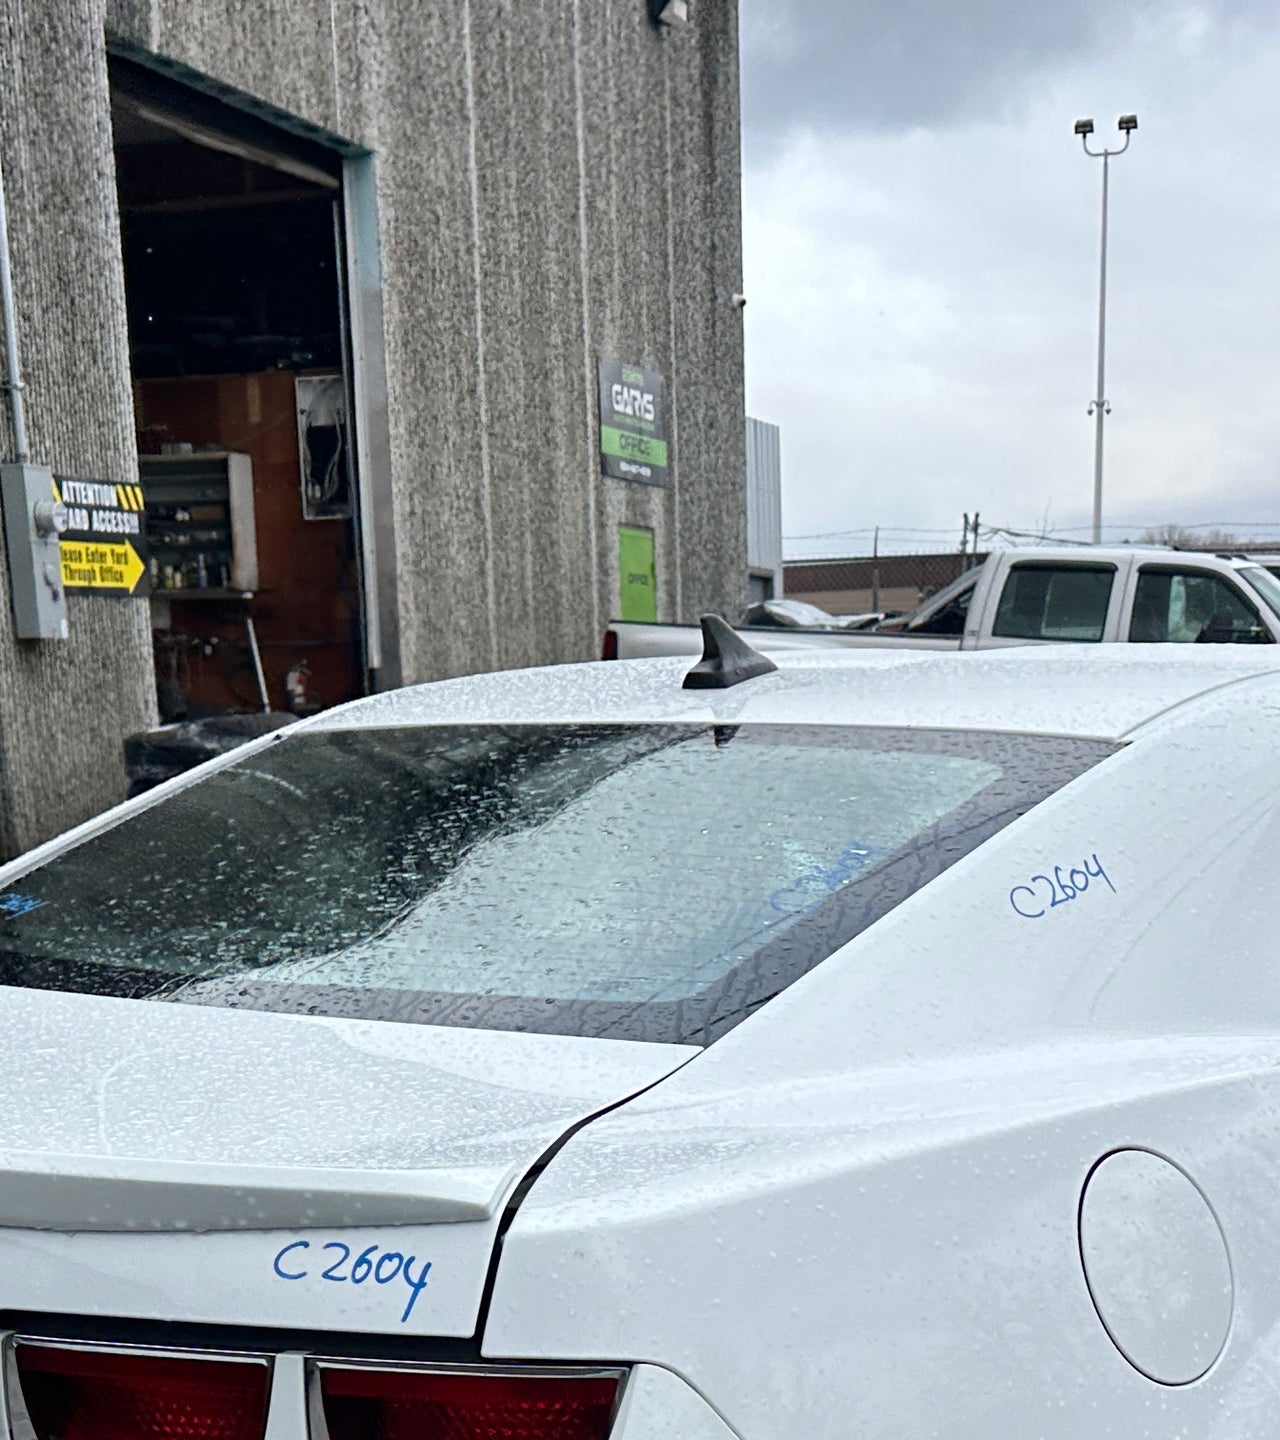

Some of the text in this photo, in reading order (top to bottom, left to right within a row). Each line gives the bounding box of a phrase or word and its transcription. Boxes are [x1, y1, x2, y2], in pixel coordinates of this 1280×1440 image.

[62, 480, 118, 507] ATTENTION
[67, 507, 89, 531] ARD
[60, 546, 128, 565] lease Enter Yard
[63, 564, 124, 584] Through Office
[1010, 854, 1117, 918] C2604
[273, 1240, 432, 1323] C2604
